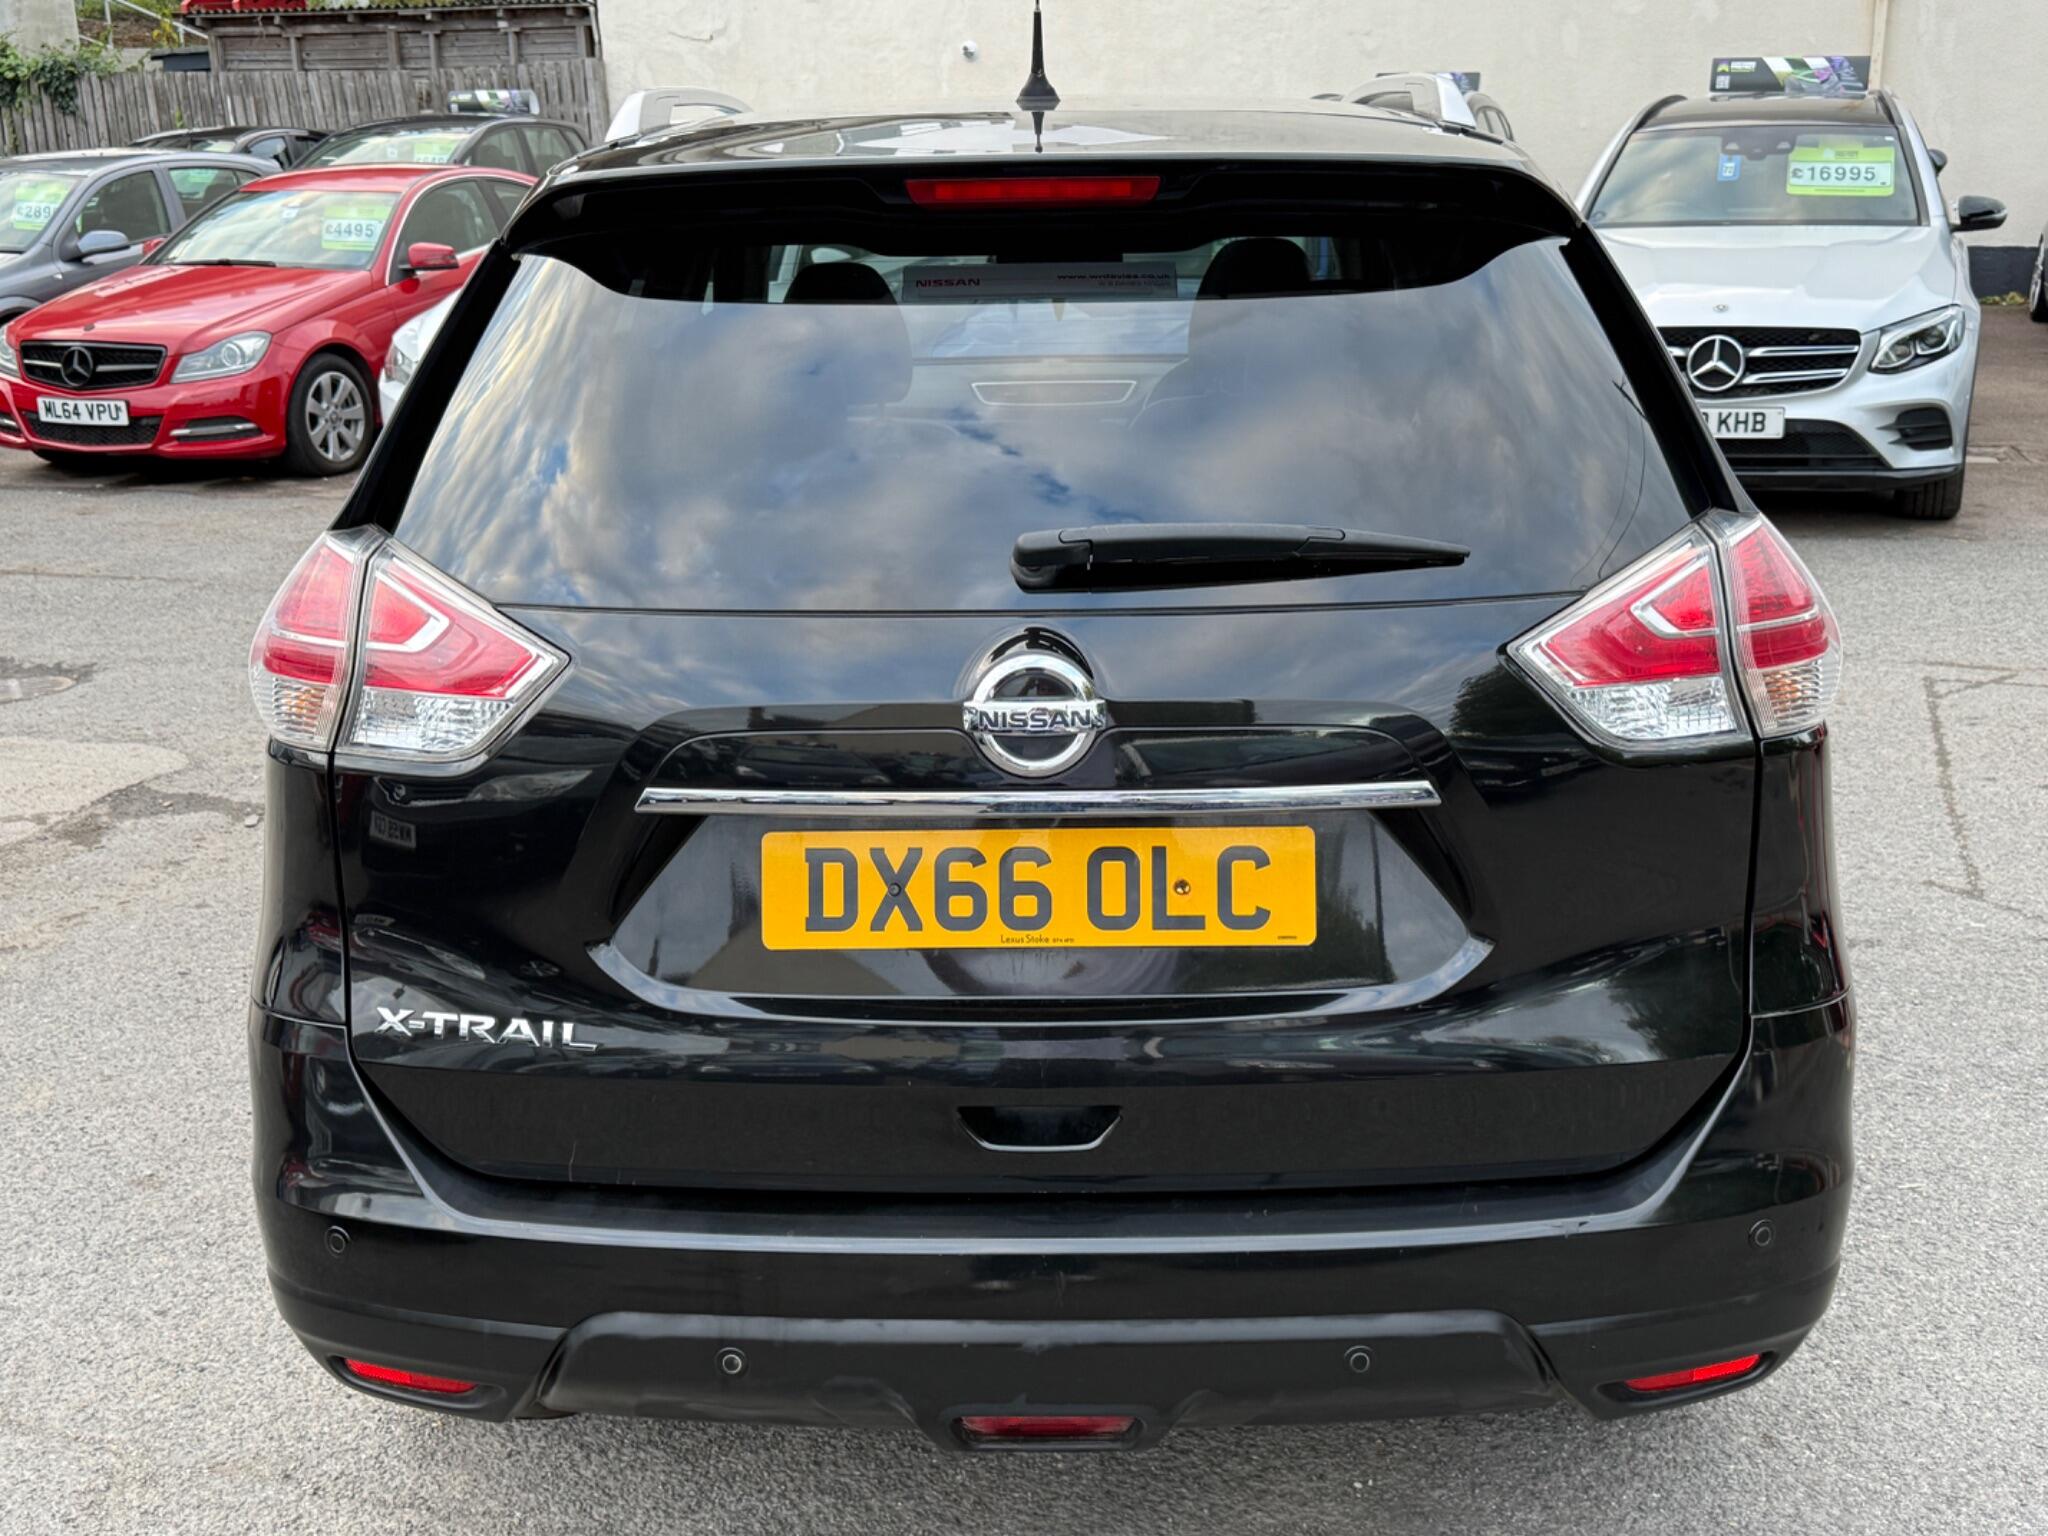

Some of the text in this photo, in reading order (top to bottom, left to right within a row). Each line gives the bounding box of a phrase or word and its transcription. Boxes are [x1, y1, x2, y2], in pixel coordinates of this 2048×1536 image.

[1791, 166, 1876, 182] £16995
[325, 222, 375, 238] £4495
[915, 278, 981, 288] NISSAN
[43, 400, 121, 421] ML64 VPU
[1717, 411, 1767, 434] KHB
[978, 709, 1092, 729] NISSAN
[804, 844, 1272, 932] DX66 OLC
[1000, 934, 1025, 944] Lexus
[1026, 934, 1050, 944] Stoke
[374, 1006, 599, 1052] X-TRAIL
